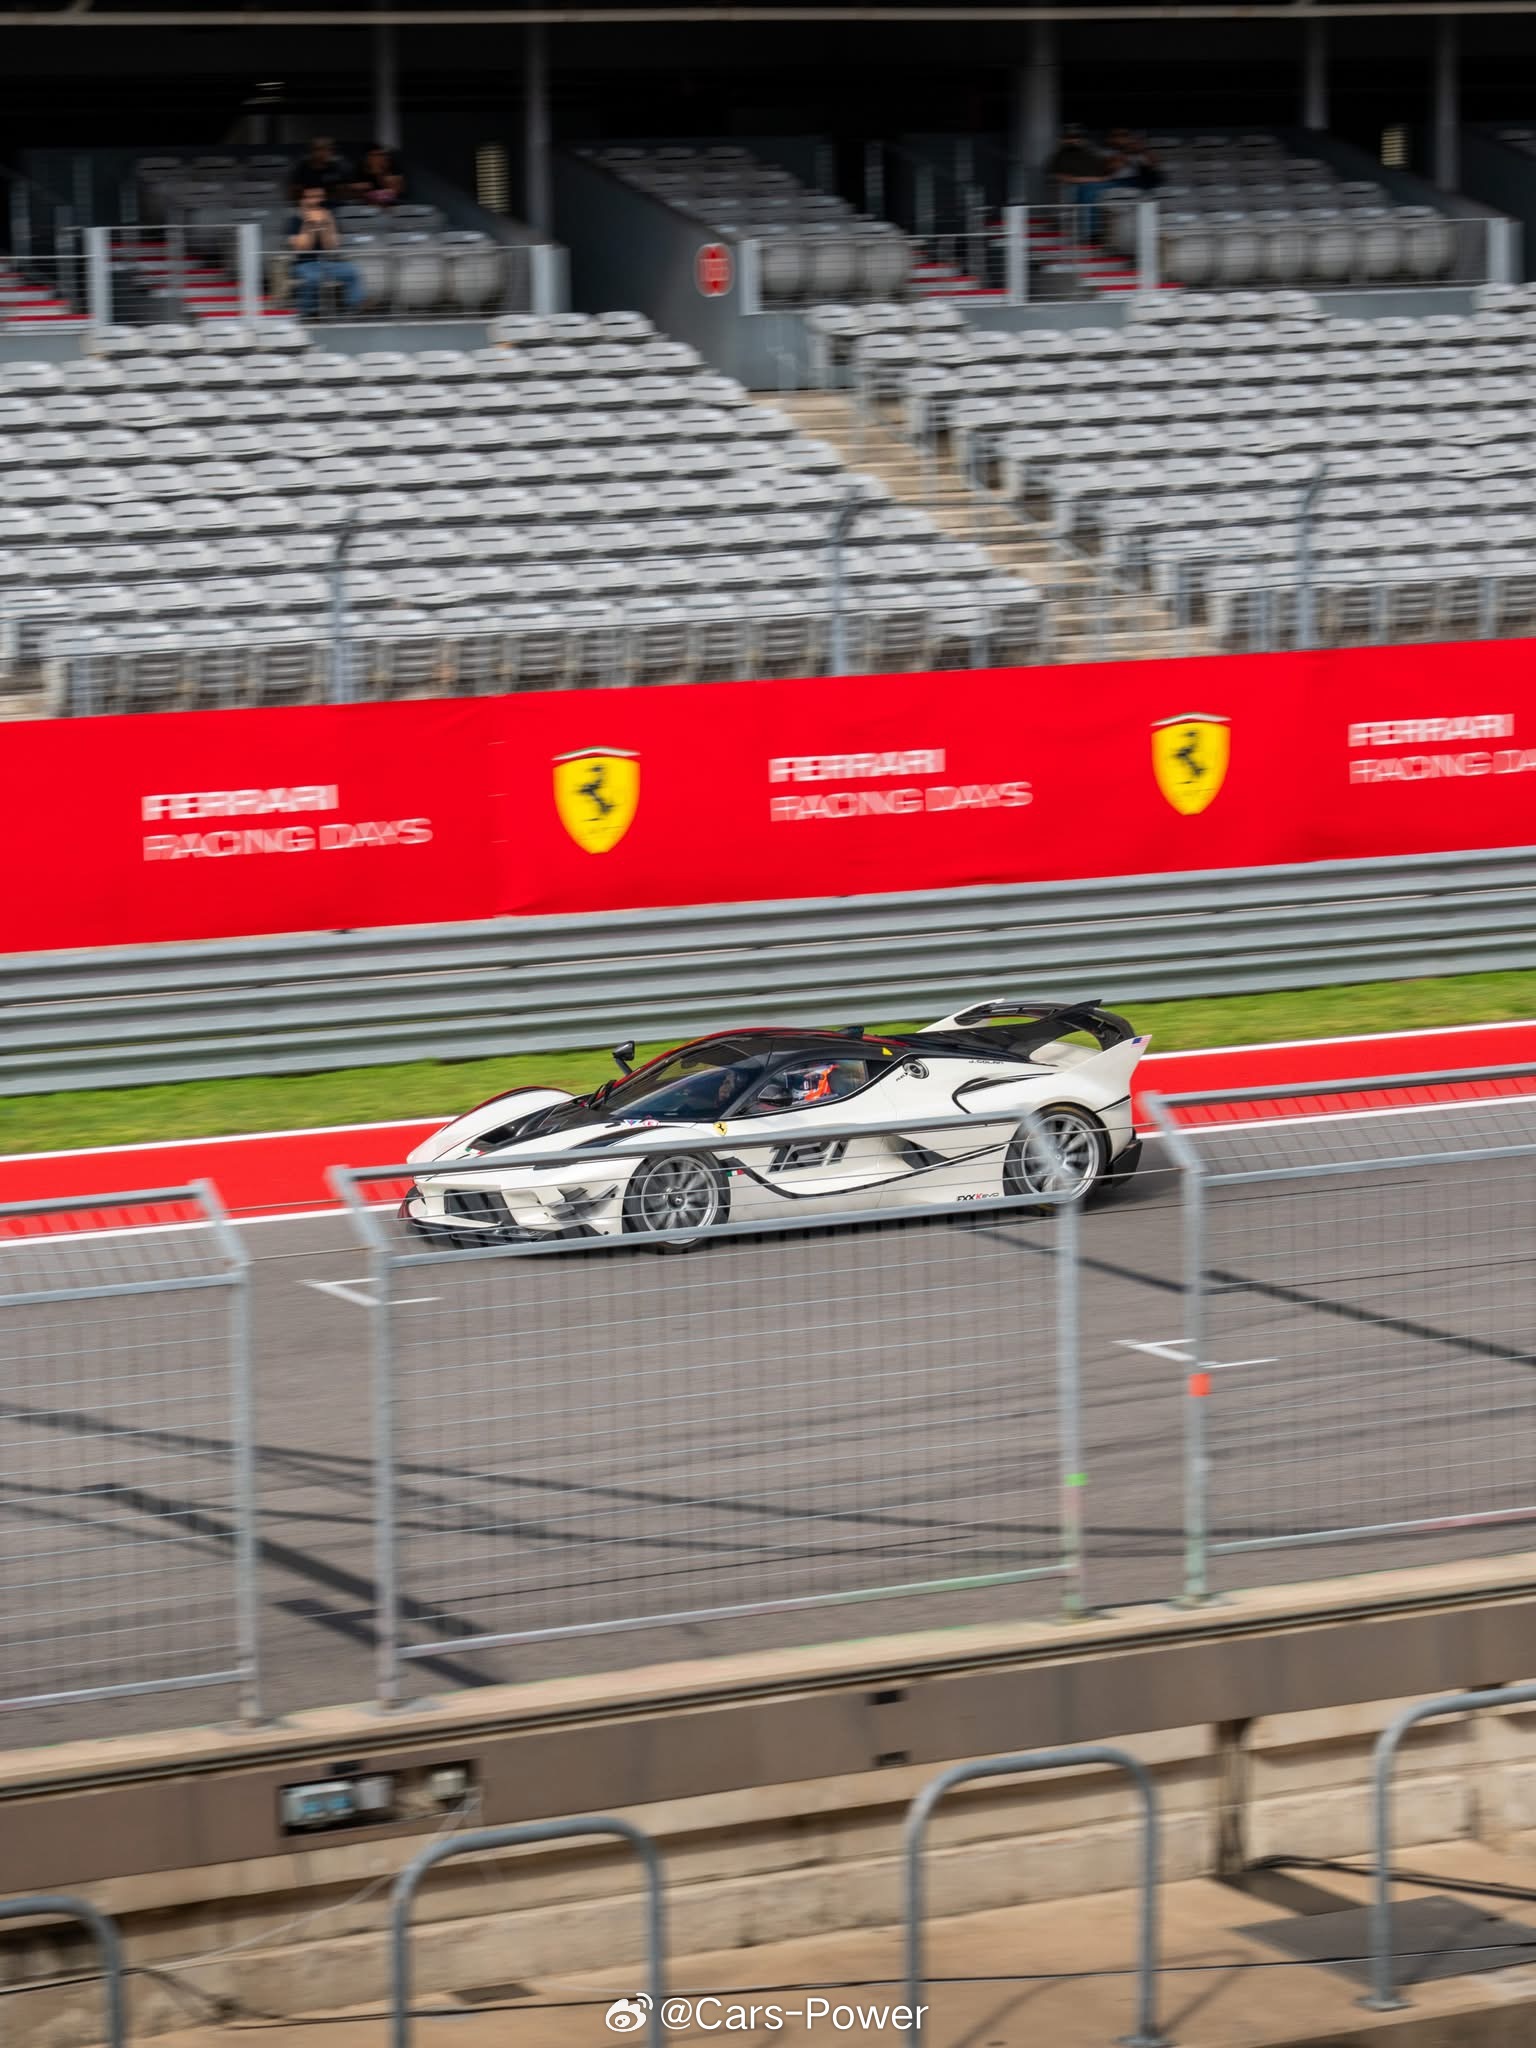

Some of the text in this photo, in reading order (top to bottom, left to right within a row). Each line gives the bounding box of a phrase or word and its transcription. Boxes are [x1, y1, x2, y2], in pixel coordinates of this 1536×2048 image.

[1348, 714, 1515, 747] FERRARI
[768, 748, 946, 783] FERRARI
[1349, 752, 1492, 784] RACING
[141, 784, 339, 821] FERRARI
[770, 781, 1033, 822] RACING DAYS
[143, 818, 434, 861] RACING DAYS
[767, 1138, 850, 1174] 121
